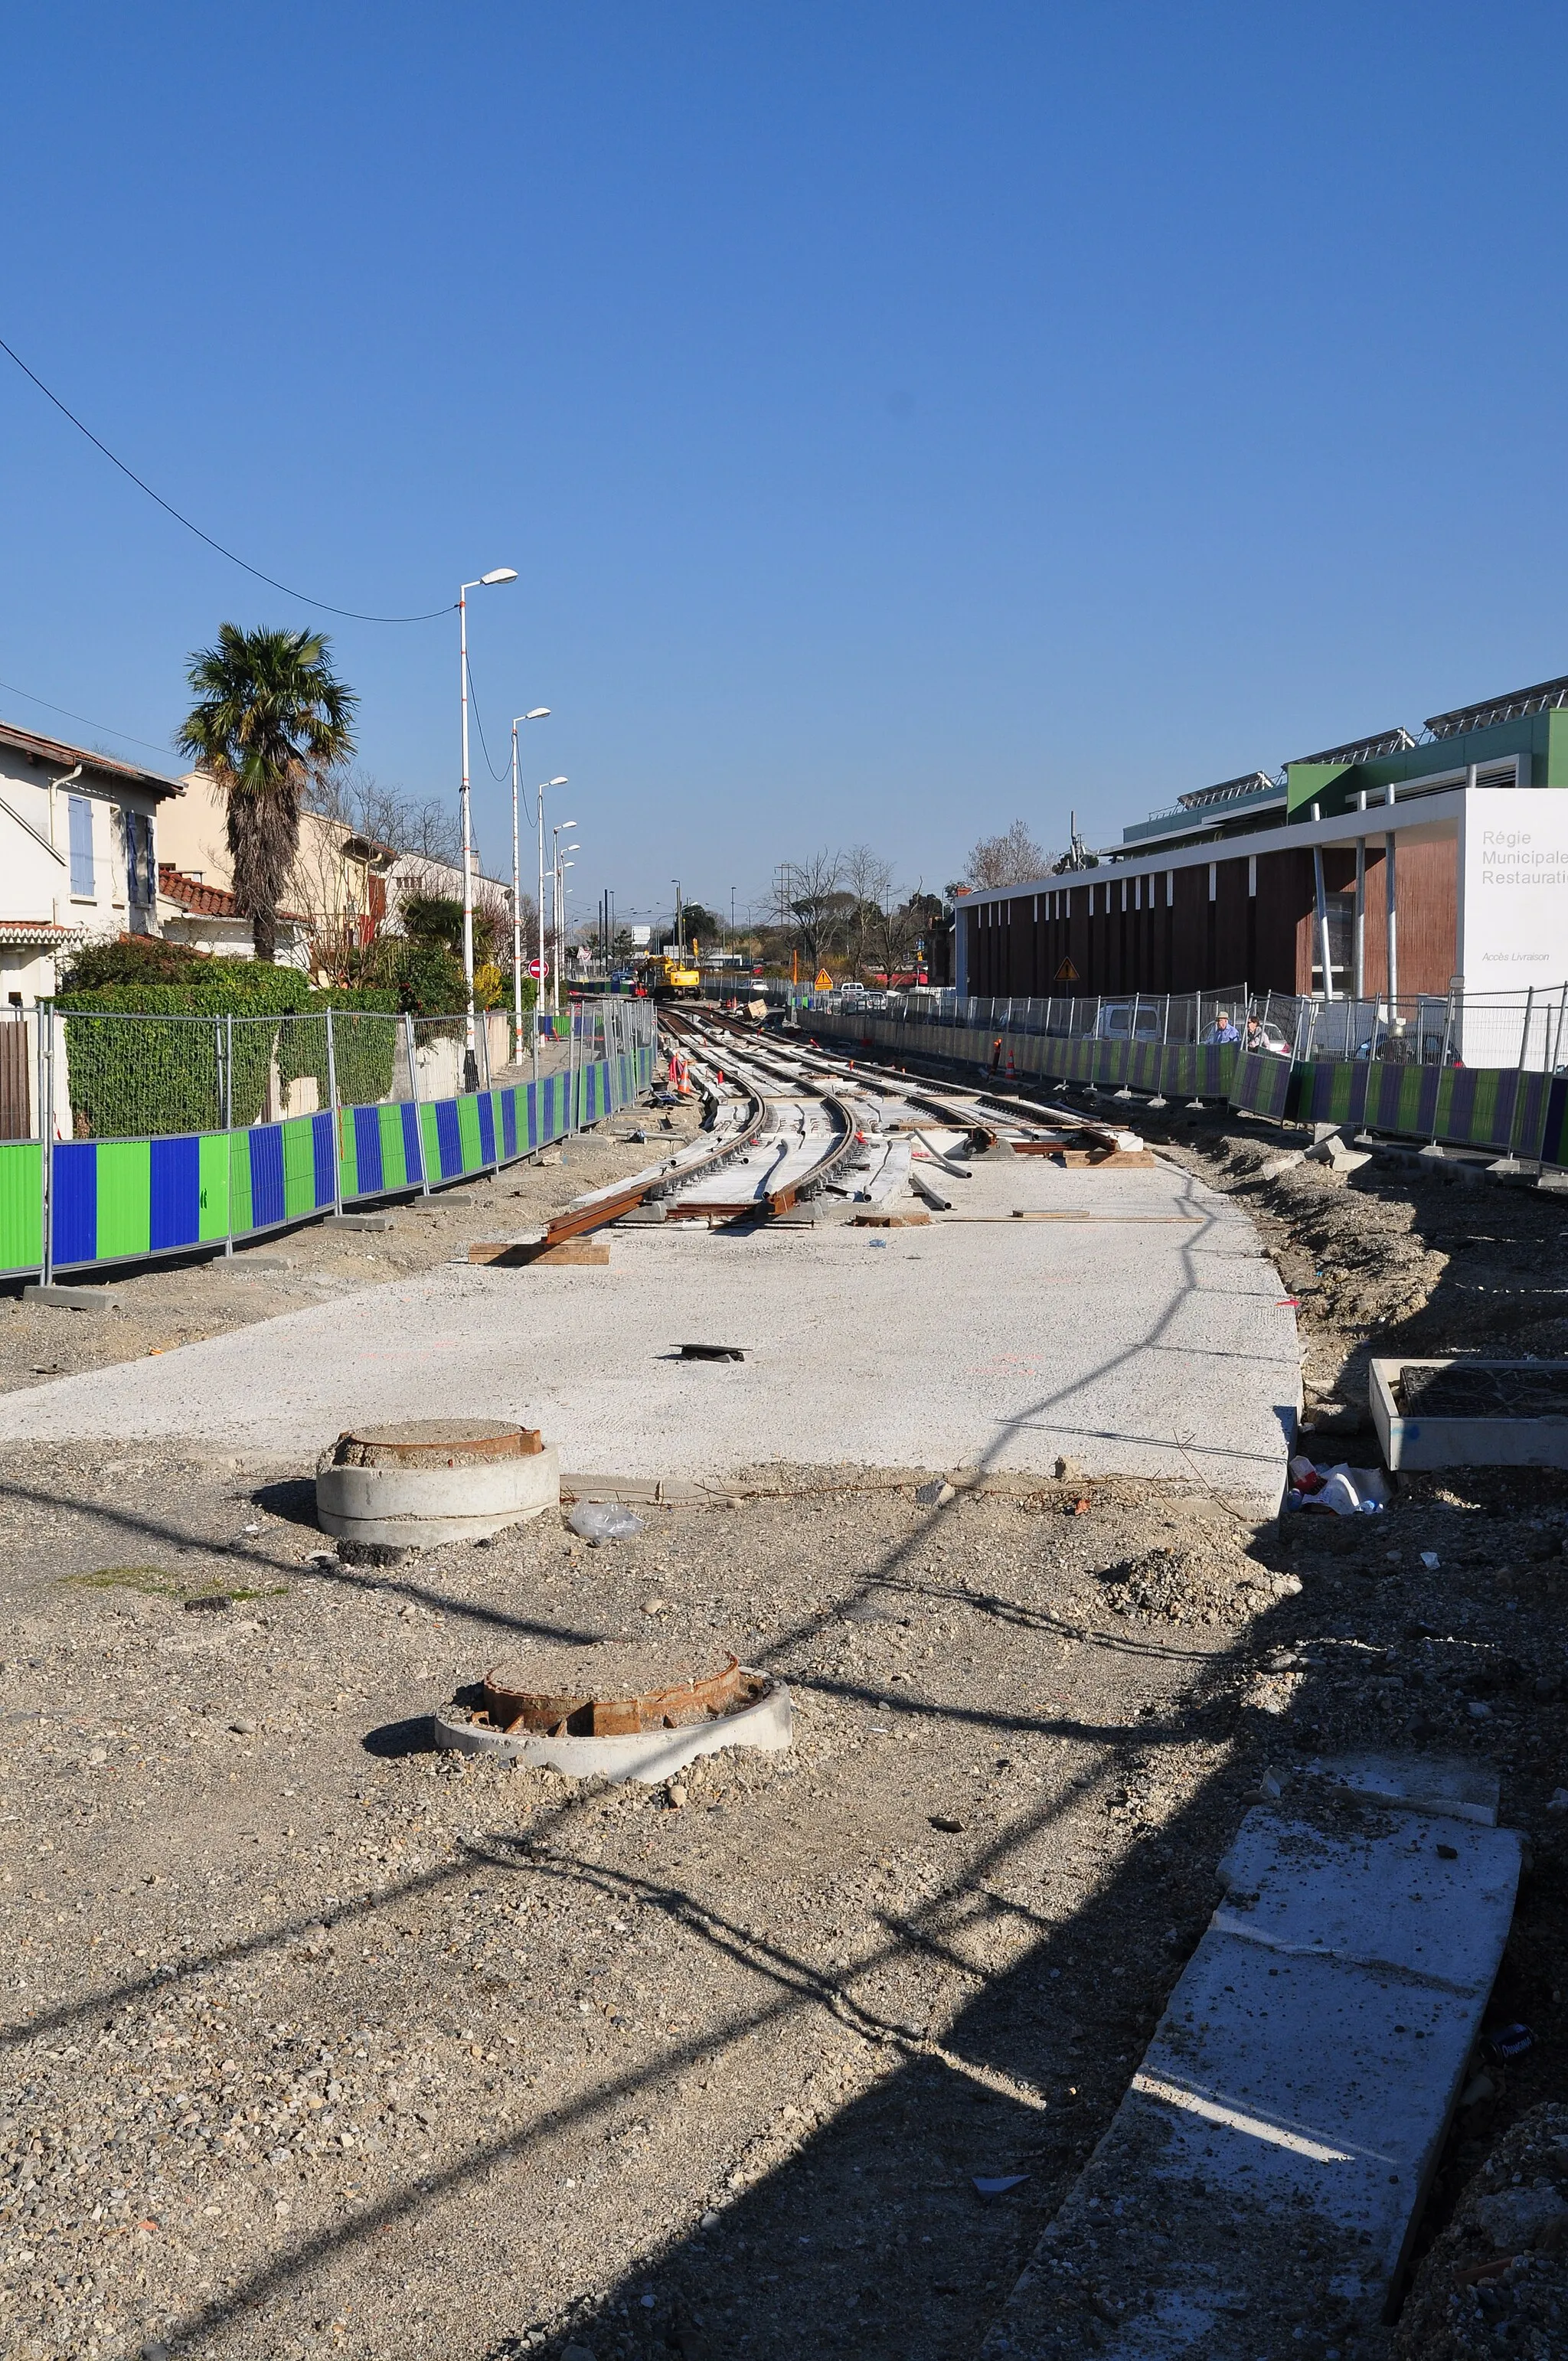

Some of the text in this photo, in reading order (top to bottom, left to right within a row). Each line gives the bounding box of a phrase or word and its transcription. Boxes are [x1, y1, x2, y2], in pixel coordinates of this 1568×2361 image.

[1483, 831, 1531, 847] Régie
[1483, 851, 1568, 867] Municipale
[1482, 870, 1568, 884] Restaurati
[1482, 952, 1550, 961] Accès Livraison
